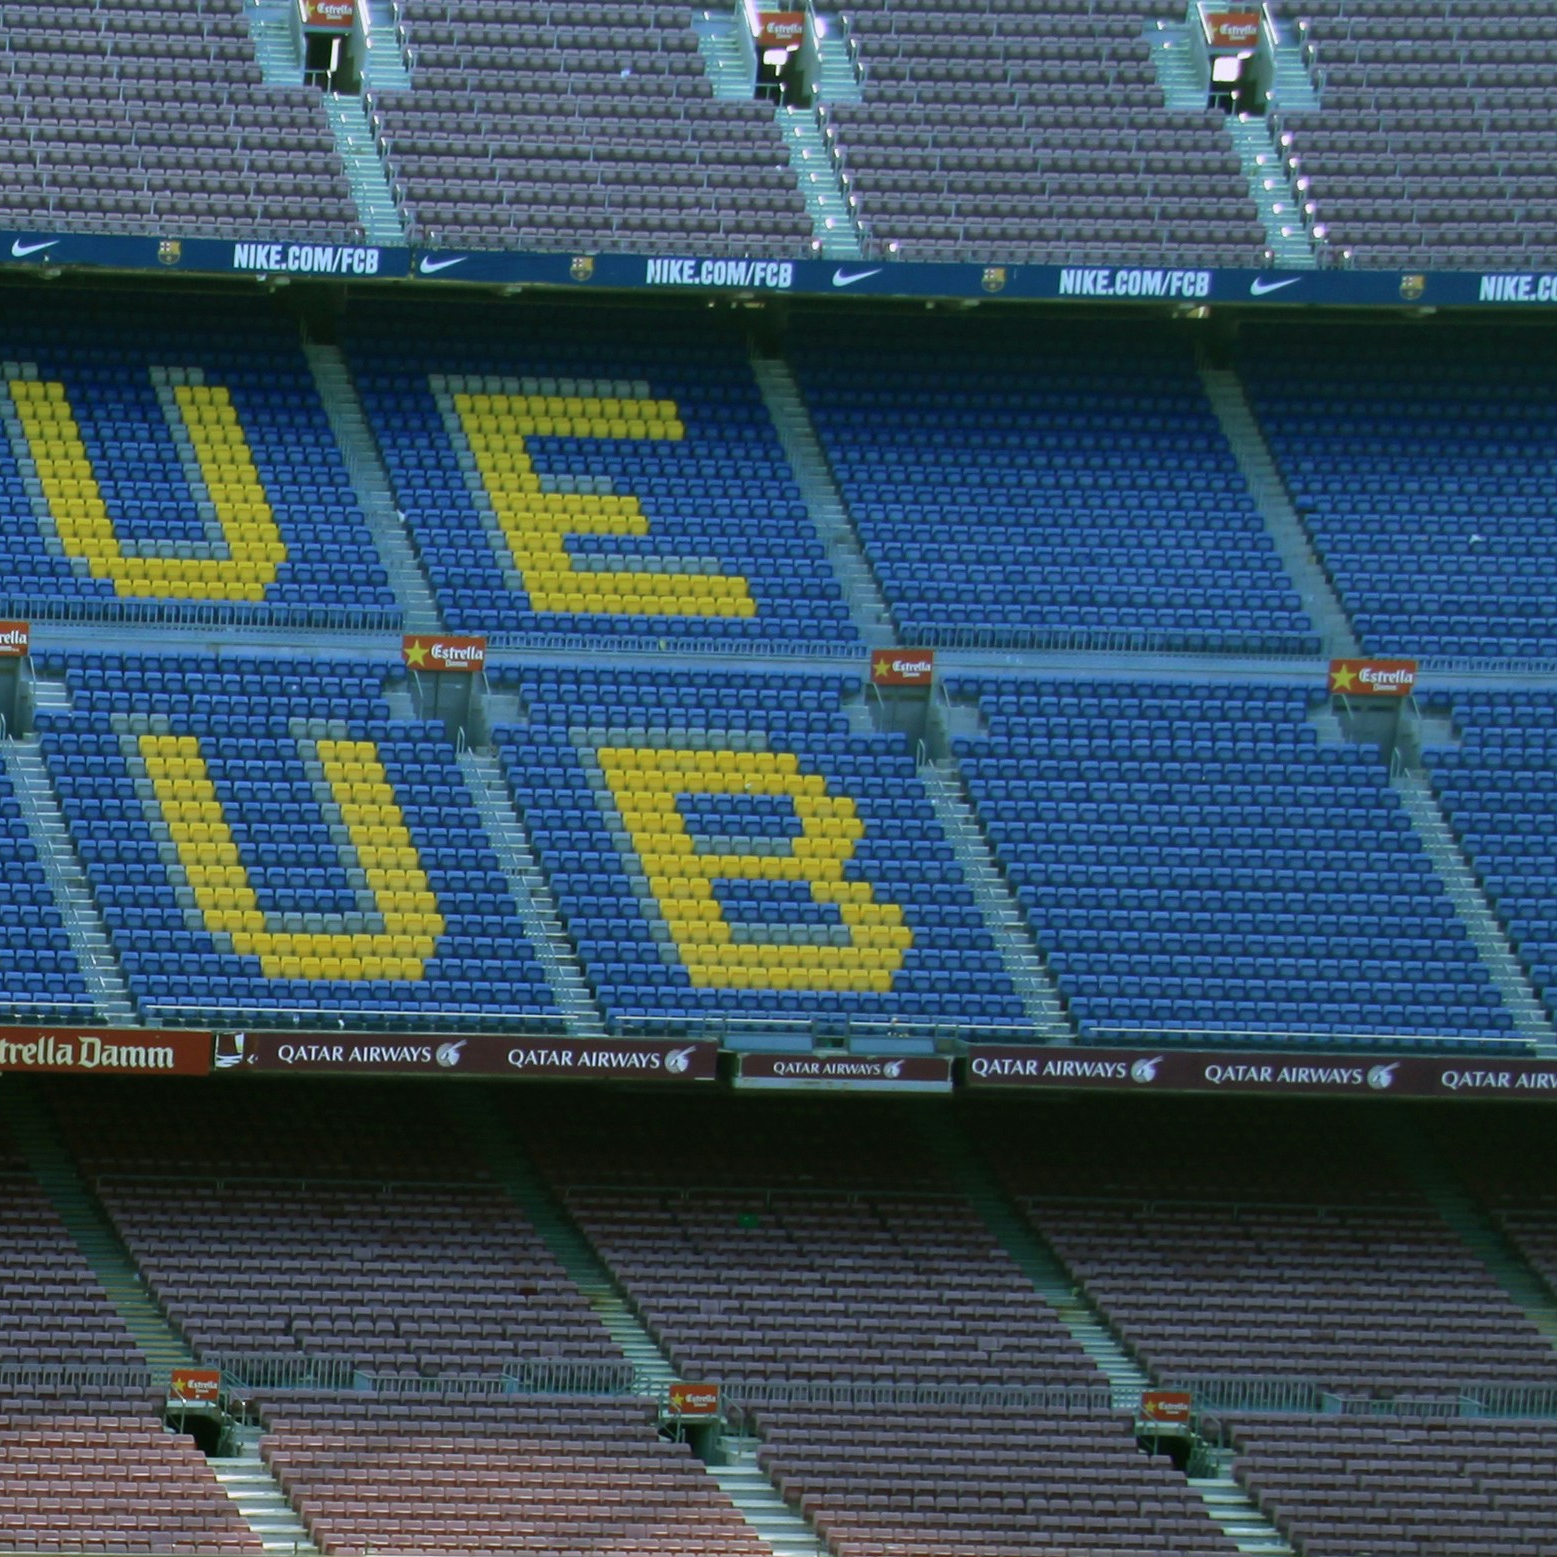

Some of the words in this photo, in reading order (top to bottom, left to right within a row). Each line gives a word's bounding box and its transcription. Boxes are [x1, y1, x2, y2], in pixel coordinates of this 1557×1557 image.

[233, 244, 379, 274] NIKE.COM/FCB
[645, 257, 792, 288] NIKE.COM/FCB
[1059, 269, 1210, 297] NIKE.COM/FCB
[431, 643, 483, 660] Estrella
[1359, 668, 1413, 683] Estrella
[77, 1035, 175, 1069] Damm
[277, 1045, 344, 1063] QATAR
[348, 1047, 432, 1062] AIRWAYS
[507, 1049, 573, 1068] QATAR
[577, 1052, 661, 1068] AIRWAYS
[773, 1062, 820, 1075] QATAR
[822, 1064, 881, 1075] AIRWAYS
[971, 1058, 1038, 1077] QATAR
[1042, 1061, 1127, 1078] AIRWAYS
[1204, 1065, 1273, 1083] QATAR
[1276, 1067, 1363, 1084] AIRWAYS
[1441, 1071, 1511, 1089] QATAR
